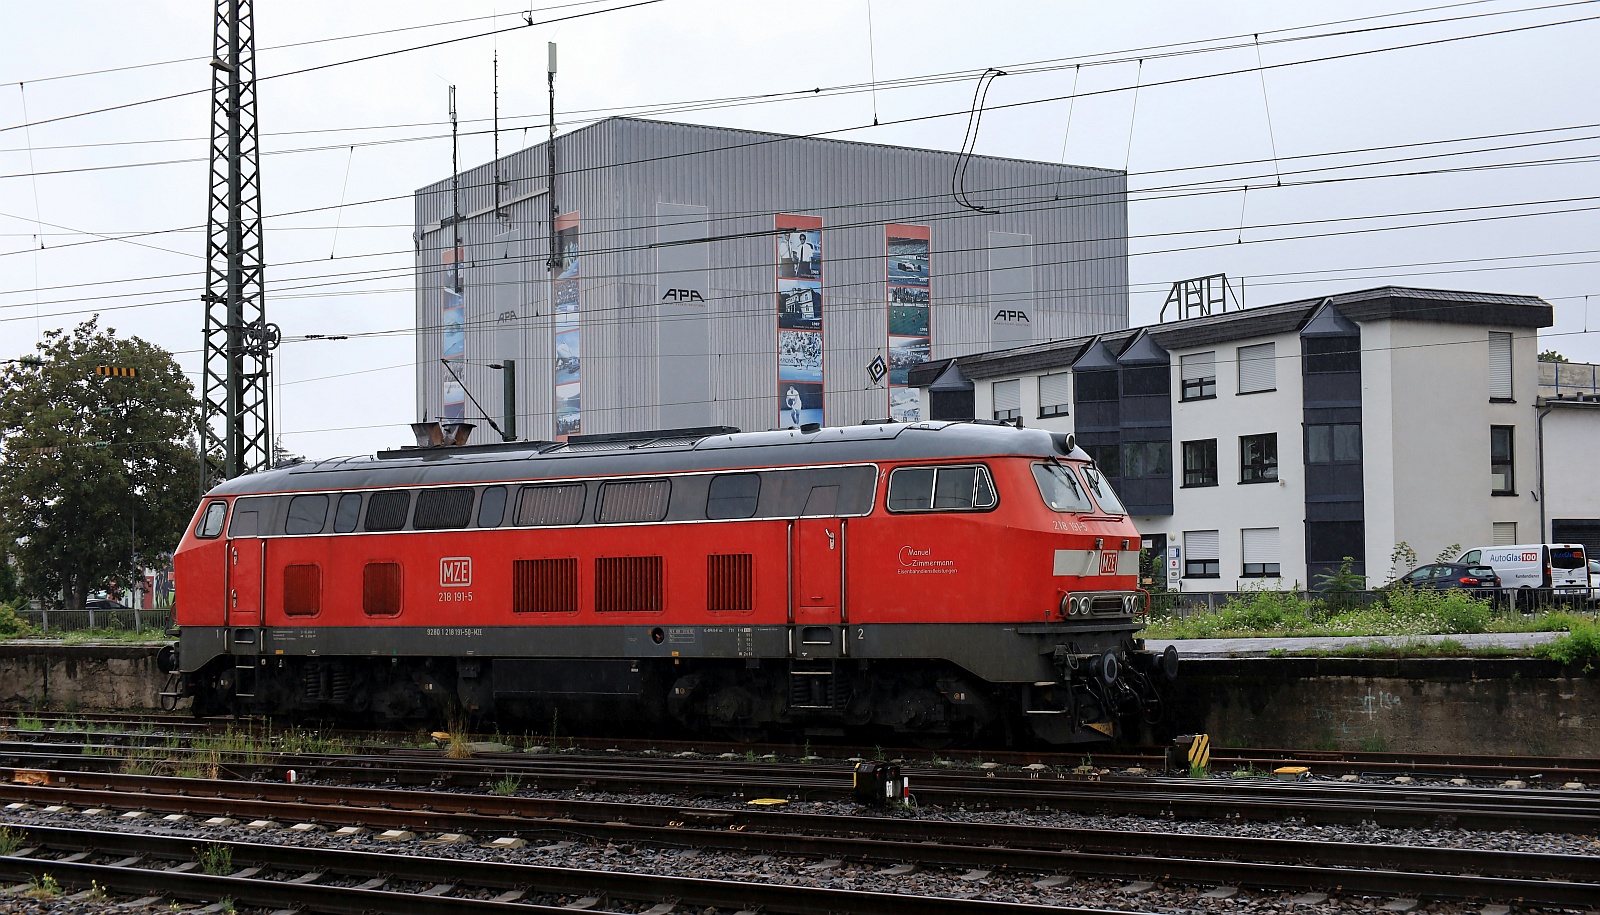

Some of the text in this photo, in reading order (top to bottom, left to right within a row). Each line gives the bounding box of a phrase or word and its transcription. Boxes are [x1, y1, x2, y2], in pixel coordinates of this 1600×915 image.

[662, 288, 705, 303] APA
[497, 310, 518, 324] APA
[993, 309, 1030, 323] APA
[1052, 520, 1088, 532] 218 191-5
[907, 548, 931, 556] Manuel
[1490, 553, 1537, 562] AutoGlas 100
[1102, 554, 1116, 572] MZE
[443, 561, 468, 582] MZE
[438, 591, 473, 602] 218 191-5
[857, 628, 864, 640] 2
